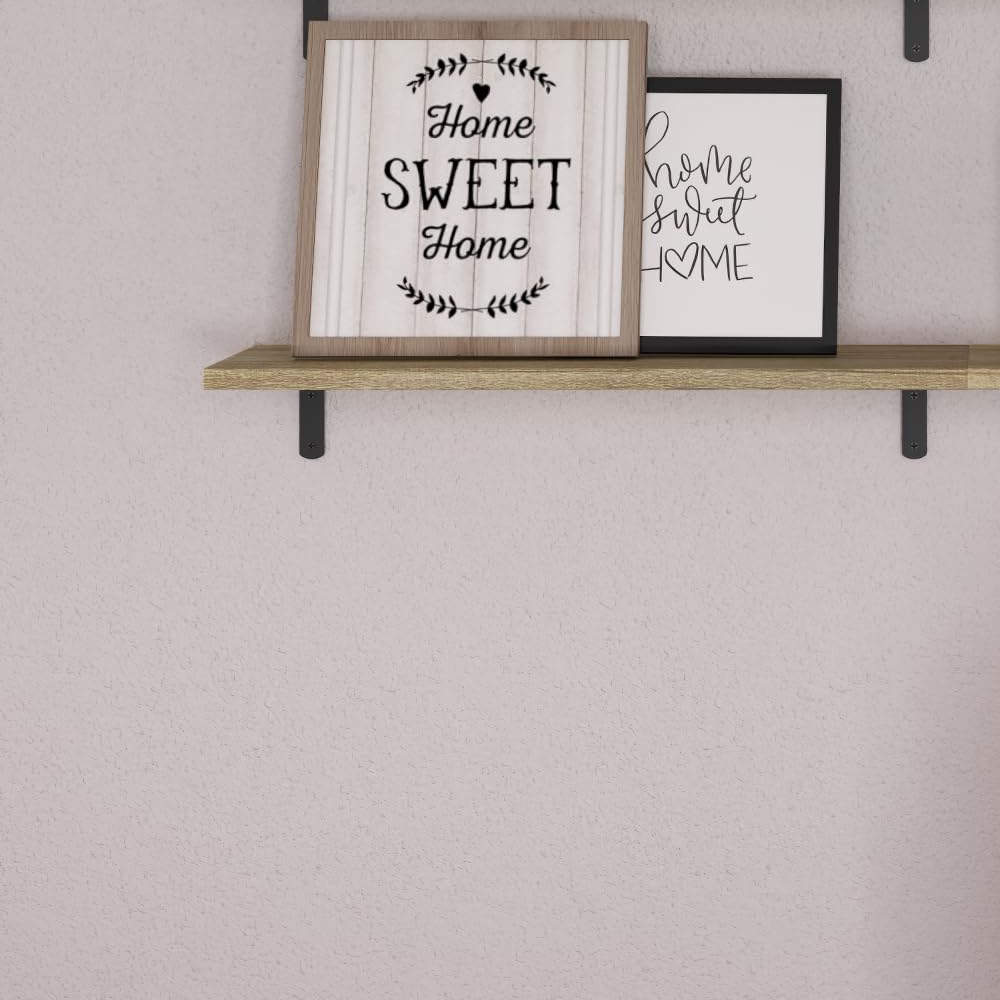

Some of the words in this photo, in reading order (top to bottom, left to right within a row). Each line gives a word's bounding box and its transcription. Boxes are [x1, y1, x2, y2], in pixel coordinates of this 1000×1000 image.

[427, 103, 536, 140] Home
[644, 110, 753, 189] home
[381, 157, 572, 211] SWEET
[642, 184, 757, 237] sweet
[421, 222, 532, 260] Home
